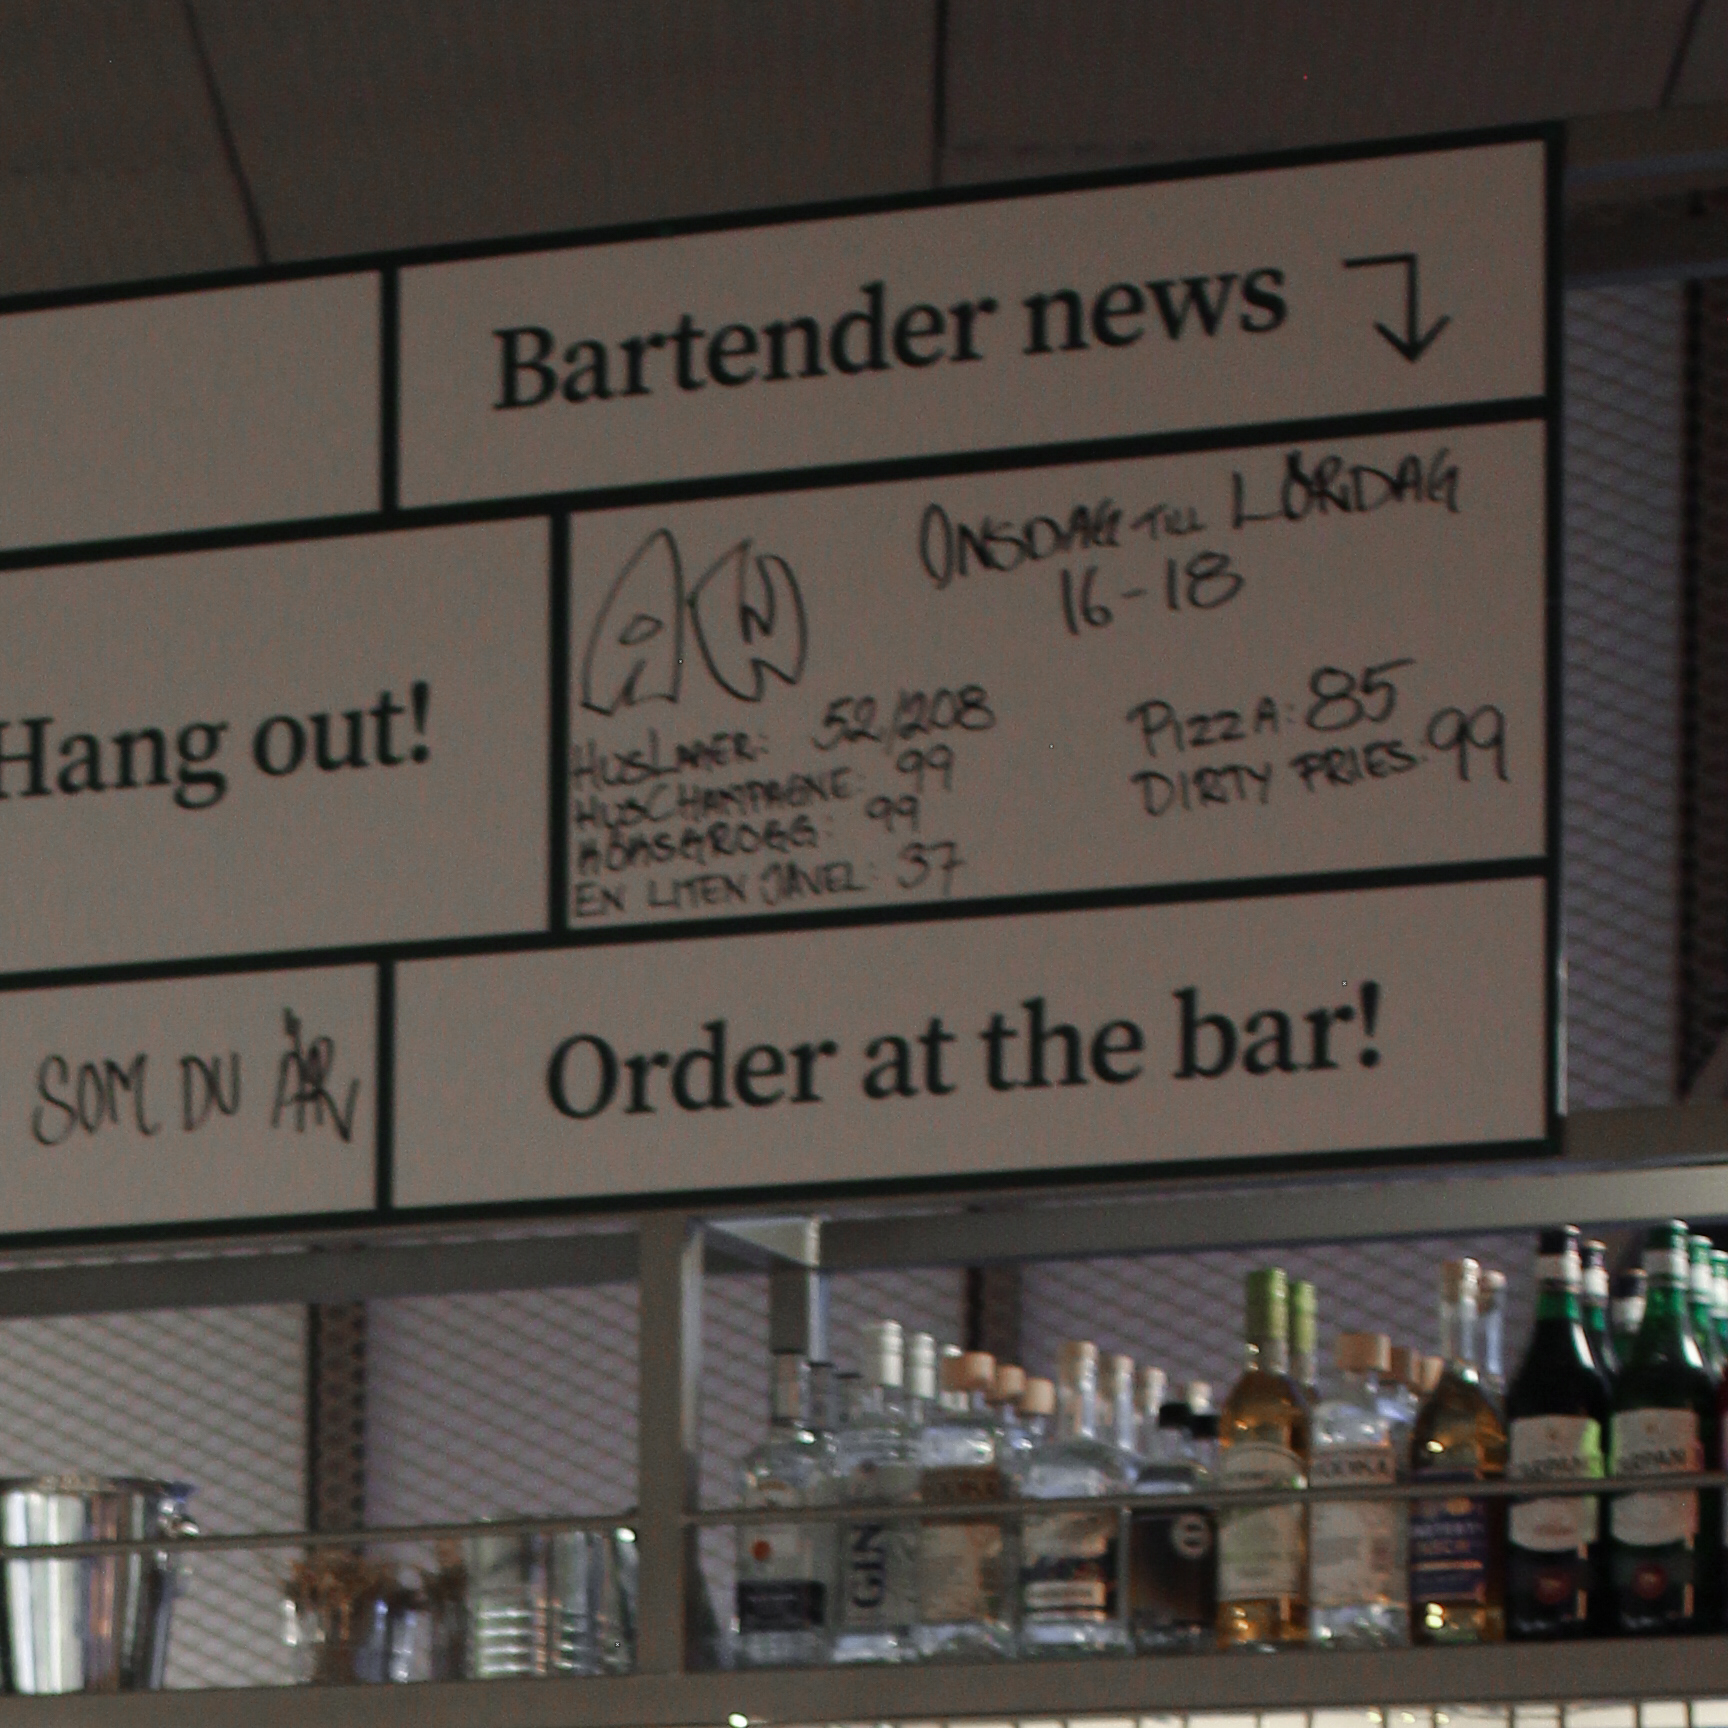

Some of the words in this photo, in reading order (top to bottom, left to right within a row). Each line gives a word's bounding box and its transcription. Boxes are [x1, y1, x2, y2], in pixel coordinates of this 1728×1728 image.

[493, 281, 998, 410] Bartender
[1023, 268, 1287, 355] news
[920, 498, 1121, 591] ONSDAG
[253, 681, 429, 776] out!
[1304, 657, 1415, 732] 85
[896, 744, 955, 793] 99
[1130, 761, 1274, 816] DIRTY
[1426, 704, 1510, 782] 99
[864, 794, 920, 833] 99
[574, 882, 625, 917] EN
[646, 874, 747, 909] LITEN
[546, 1020, 837, 1119] Order
[863, 1018, 954, 1099] at
[980, 997, 1143, 1091] the
[1173, 981, 1379, 1079] bar!
[32, 1054, 160, 1146] SOM
[180, 1052, 240, 1133] DU
